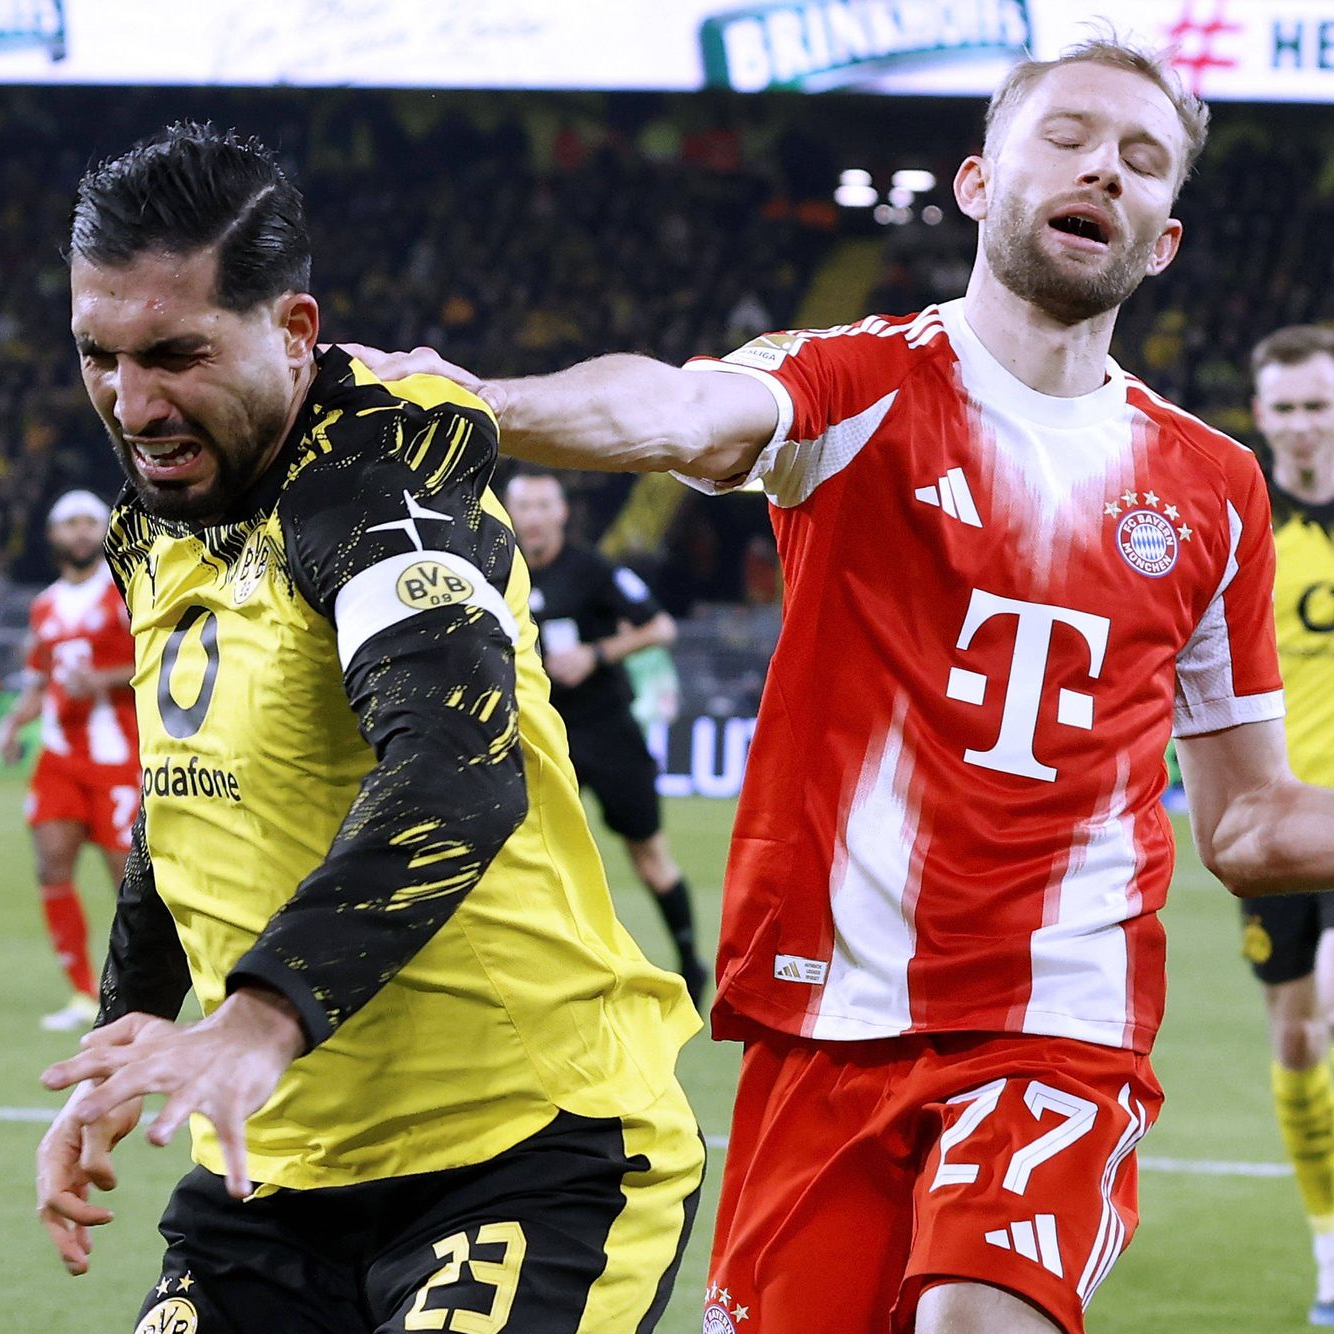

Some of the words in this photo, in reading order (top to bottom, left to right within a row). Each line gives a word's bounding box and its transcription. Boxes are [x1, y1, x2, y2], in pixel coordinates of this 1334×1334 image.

[1137, 514, 1175, 546] BAYERN
[405, 566, 467, 601] BVB
[143, 756, 241, 802] odafone
[928, 1077, 1098, 1197] 27
